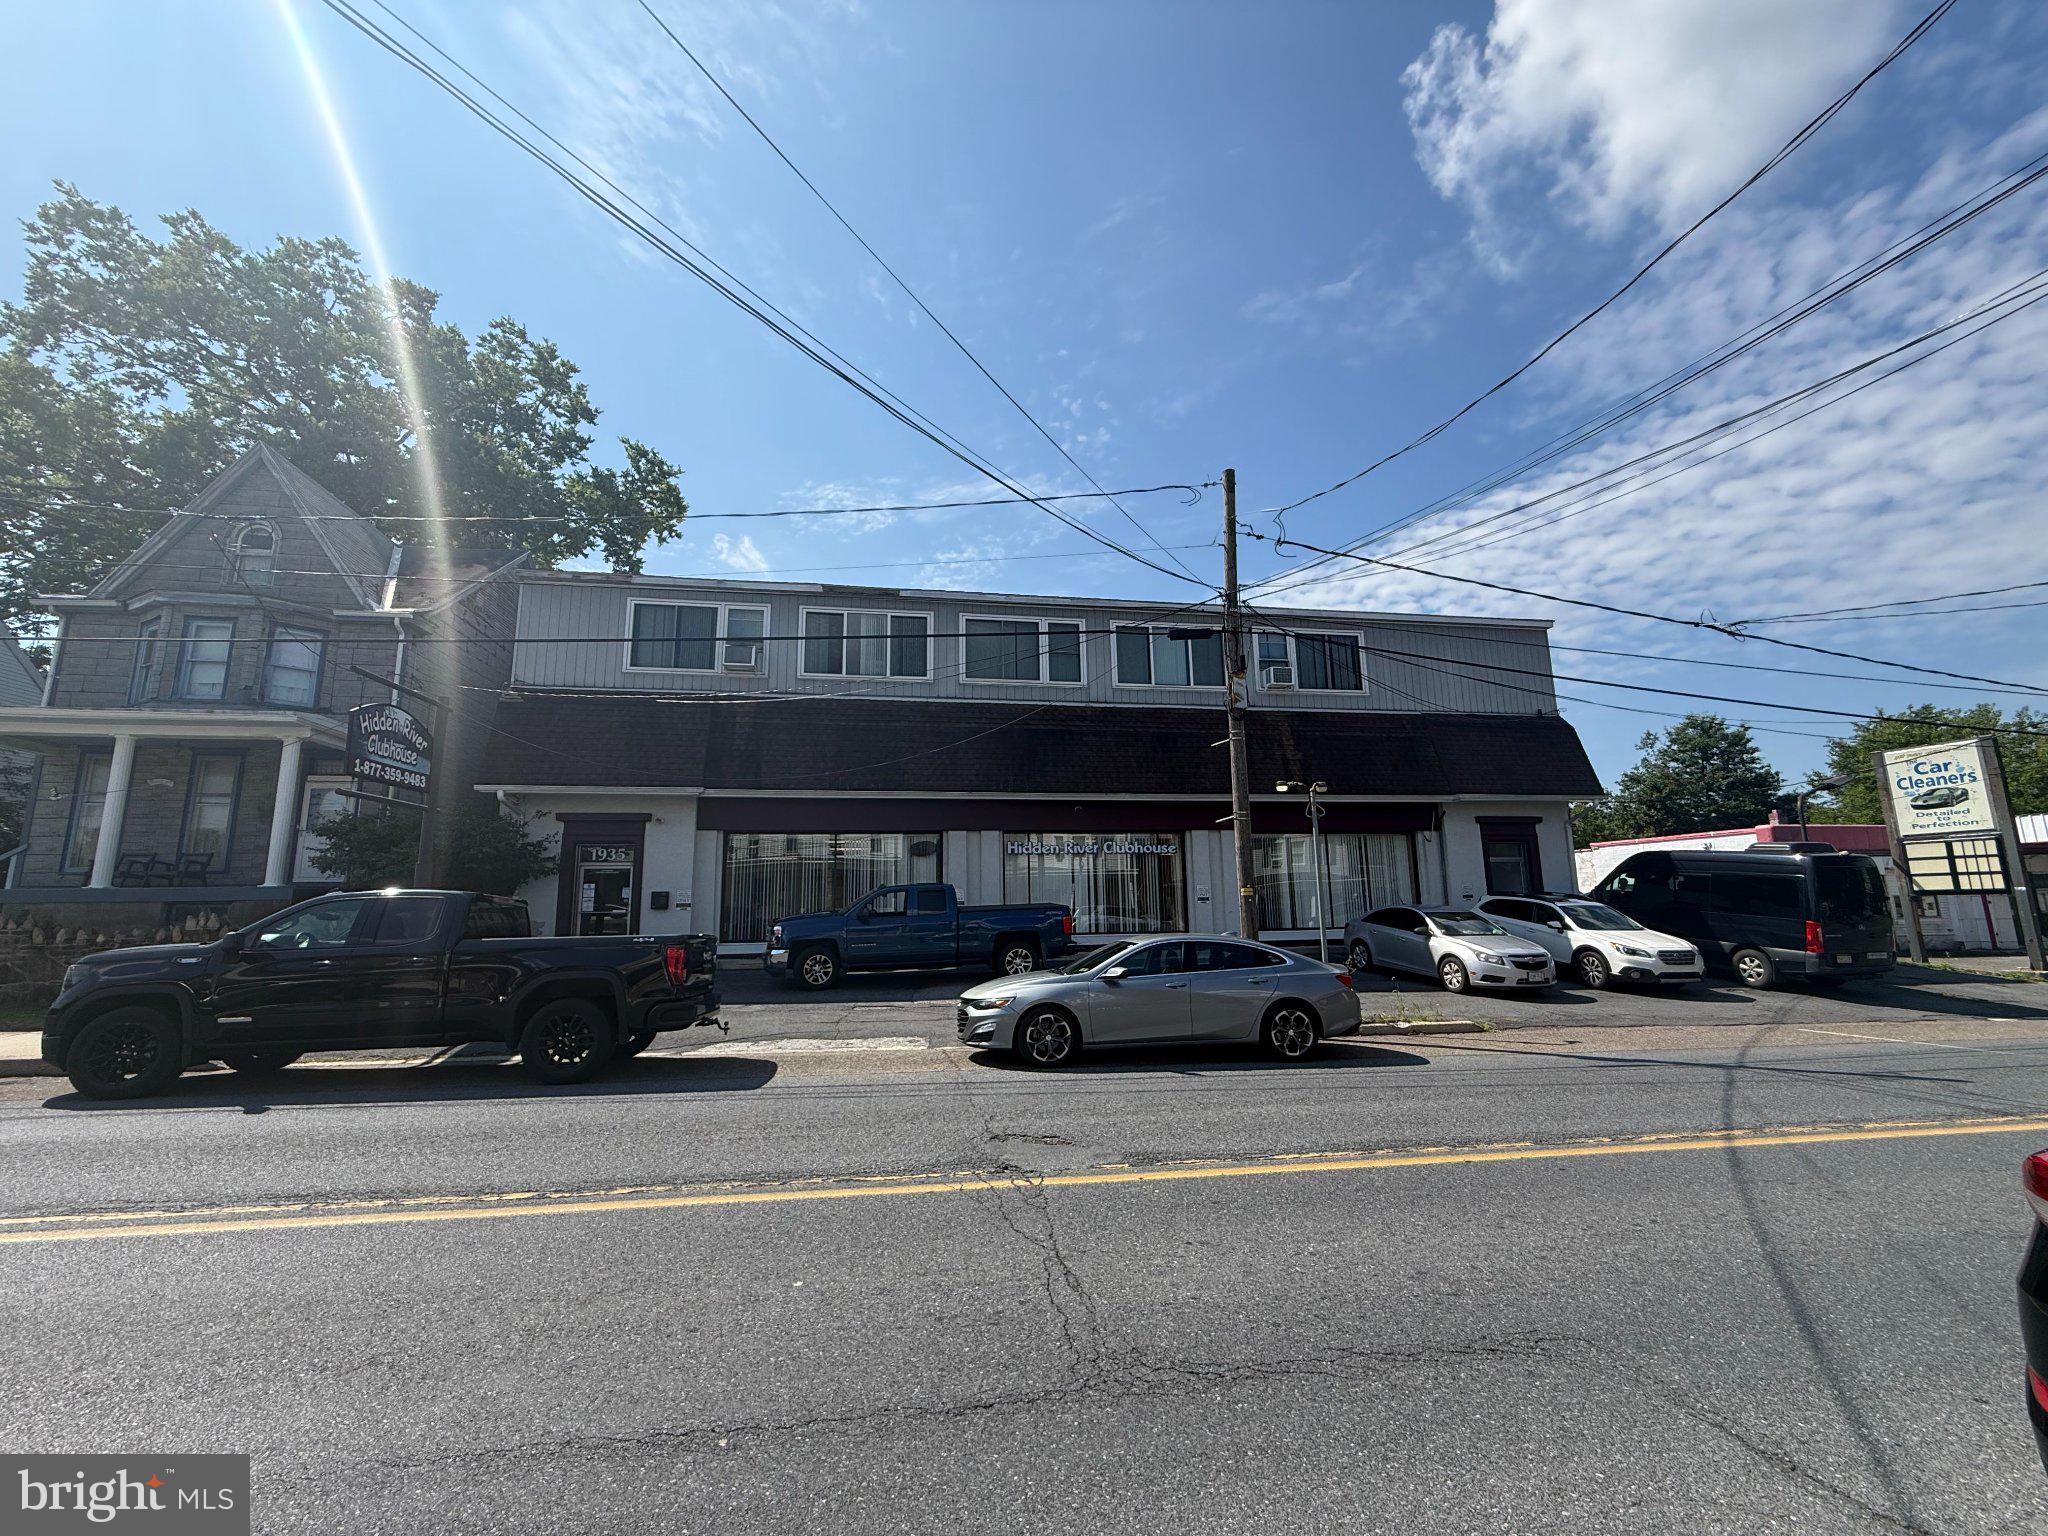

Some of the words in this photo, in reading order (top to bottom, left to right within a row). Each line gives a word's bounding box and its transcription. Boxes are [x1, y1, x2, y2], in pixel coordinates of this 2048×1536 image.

[360, 711, 401, 734] Hidden
[402, 720, 428, 751] River
[367, 734, 418, 765] Clubhouse
[354, 758, 426, 788] 1-877-359-9483
[1913, 761, 1952, 775] Car
[1896, 771, 1978, 790] Cleaners
[1916, 808, 1970, 818] Detailed
[1911, 820, 1979, 829] Perfection
[587, 848, 625, 861] 1935
[1007, 841, 1059, 854] Hidden
[1064, 841, 1099, 854] River
[1103, 841, 1177, 854] Clubhouse
